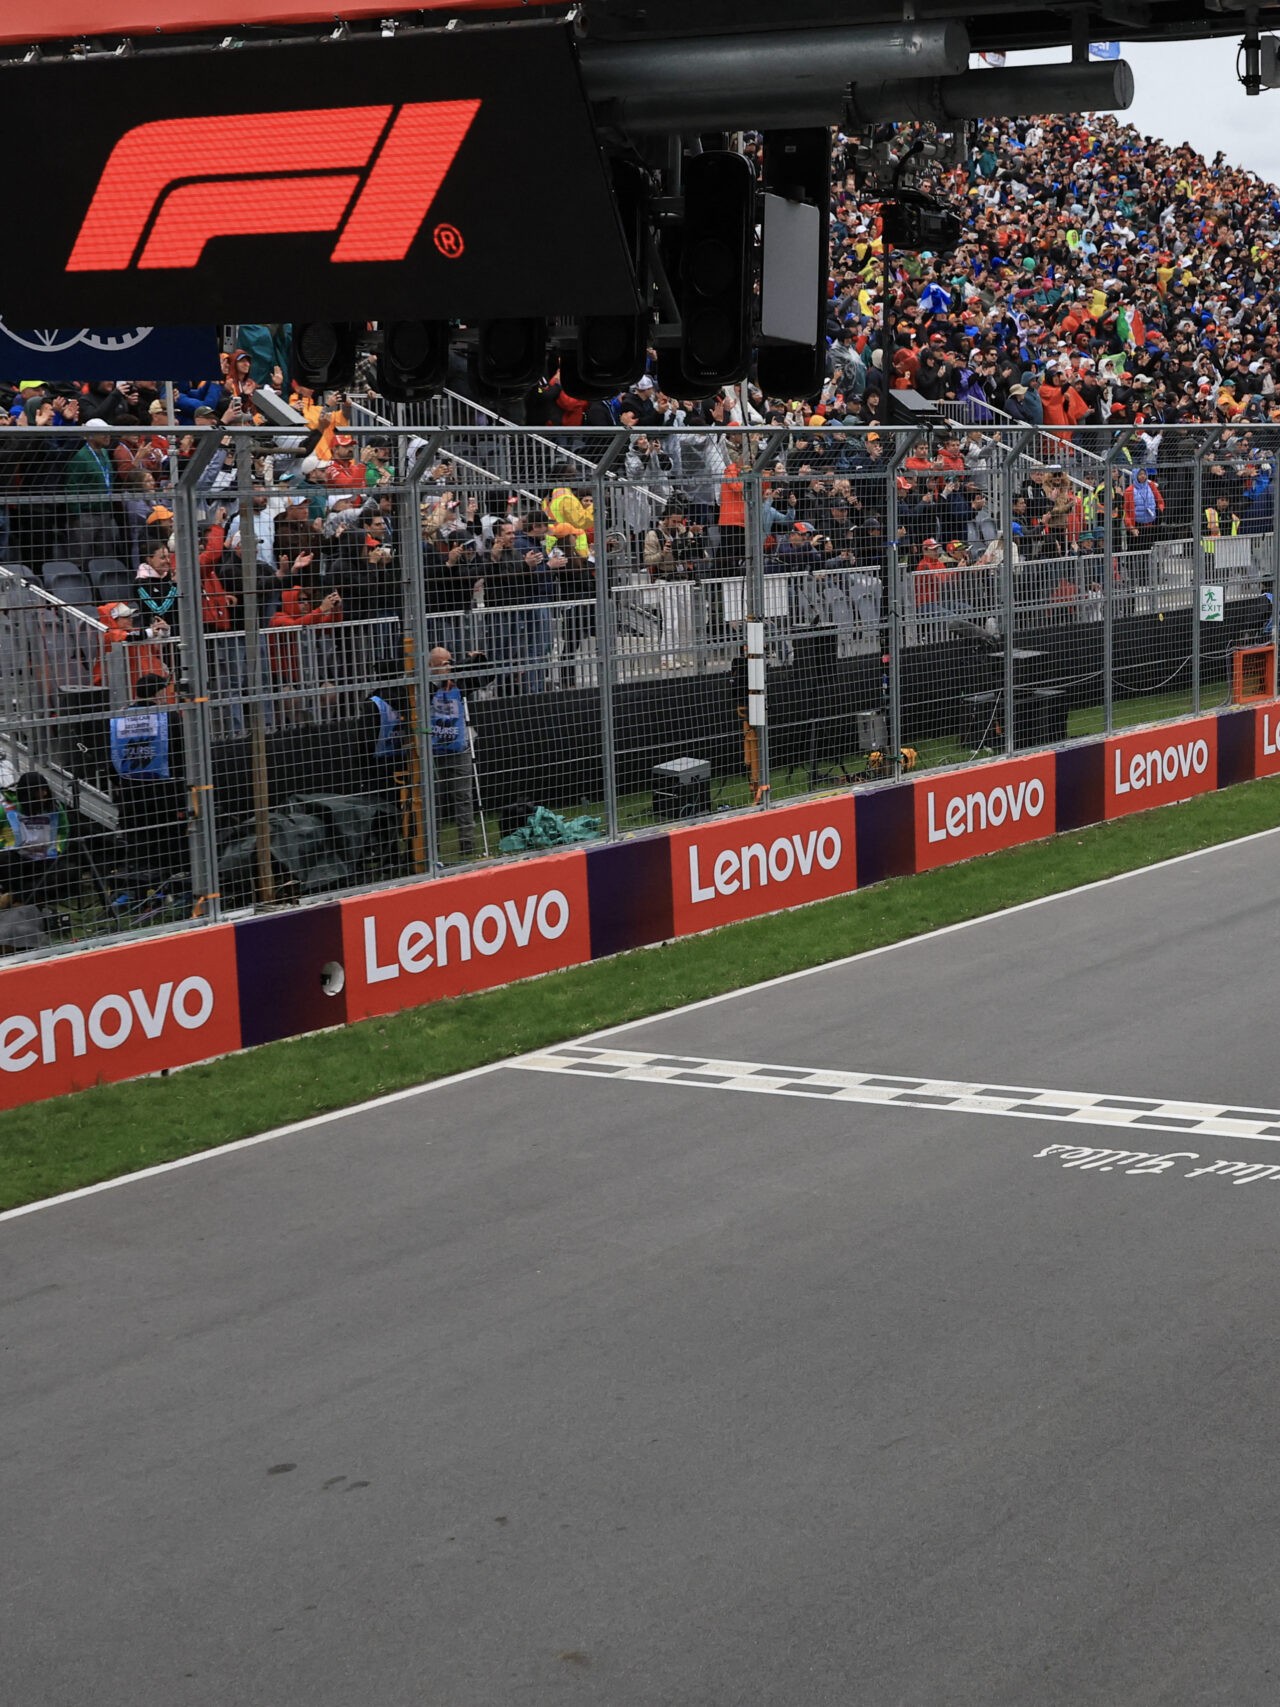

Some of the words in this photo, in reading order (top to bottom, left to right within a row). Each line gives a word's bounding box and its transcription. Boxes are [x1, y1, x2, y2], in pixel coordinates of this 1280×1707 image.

[65, 100, 481, 271] F1
[1201, 604, 1222, 612] EXIT
[1115, 739, 1209, 795] Lenovo
[926, 778, 1045, 843] Lenovo
[688, 825, 842, 904] Lenovo
[364, 889, 570, 984] Lenovo
[0, 975, 214, 1073] enovo
[1033, 1144, 1200, 1175] Gilles
